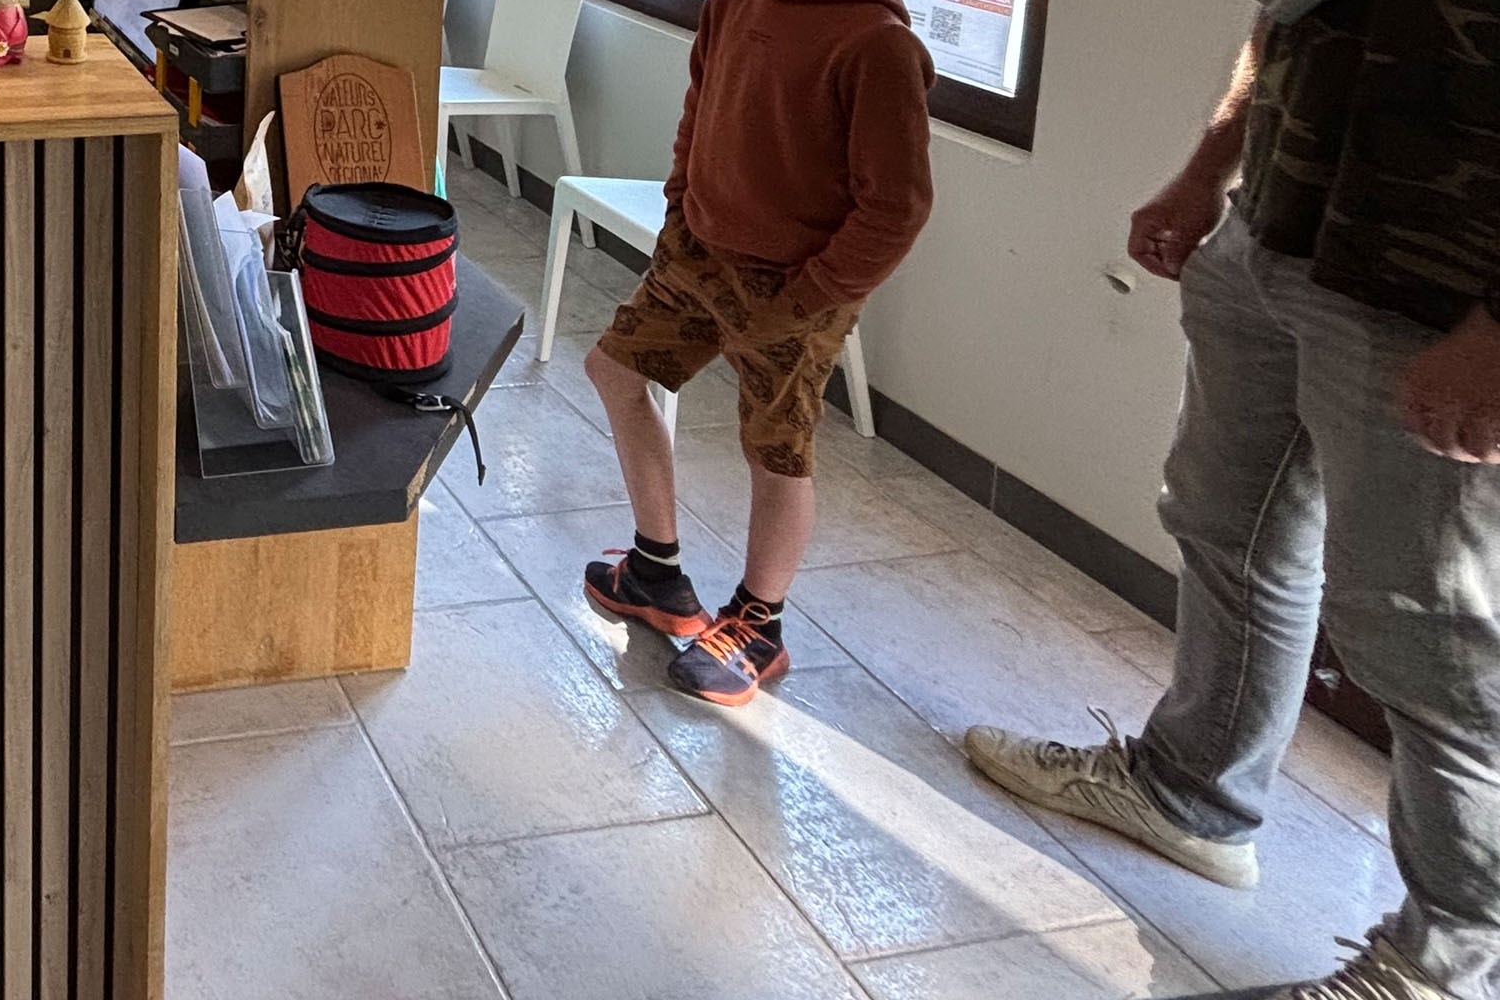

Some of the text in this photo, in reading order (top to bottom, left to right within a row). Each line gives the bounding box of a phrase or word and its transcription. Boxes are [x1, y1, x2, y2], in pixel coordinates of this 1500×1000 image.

[322, 79, 376, 106] VALEURS
[320, 108, 384, 140] PARC
[323, 141, 386, 164] NATUREL
